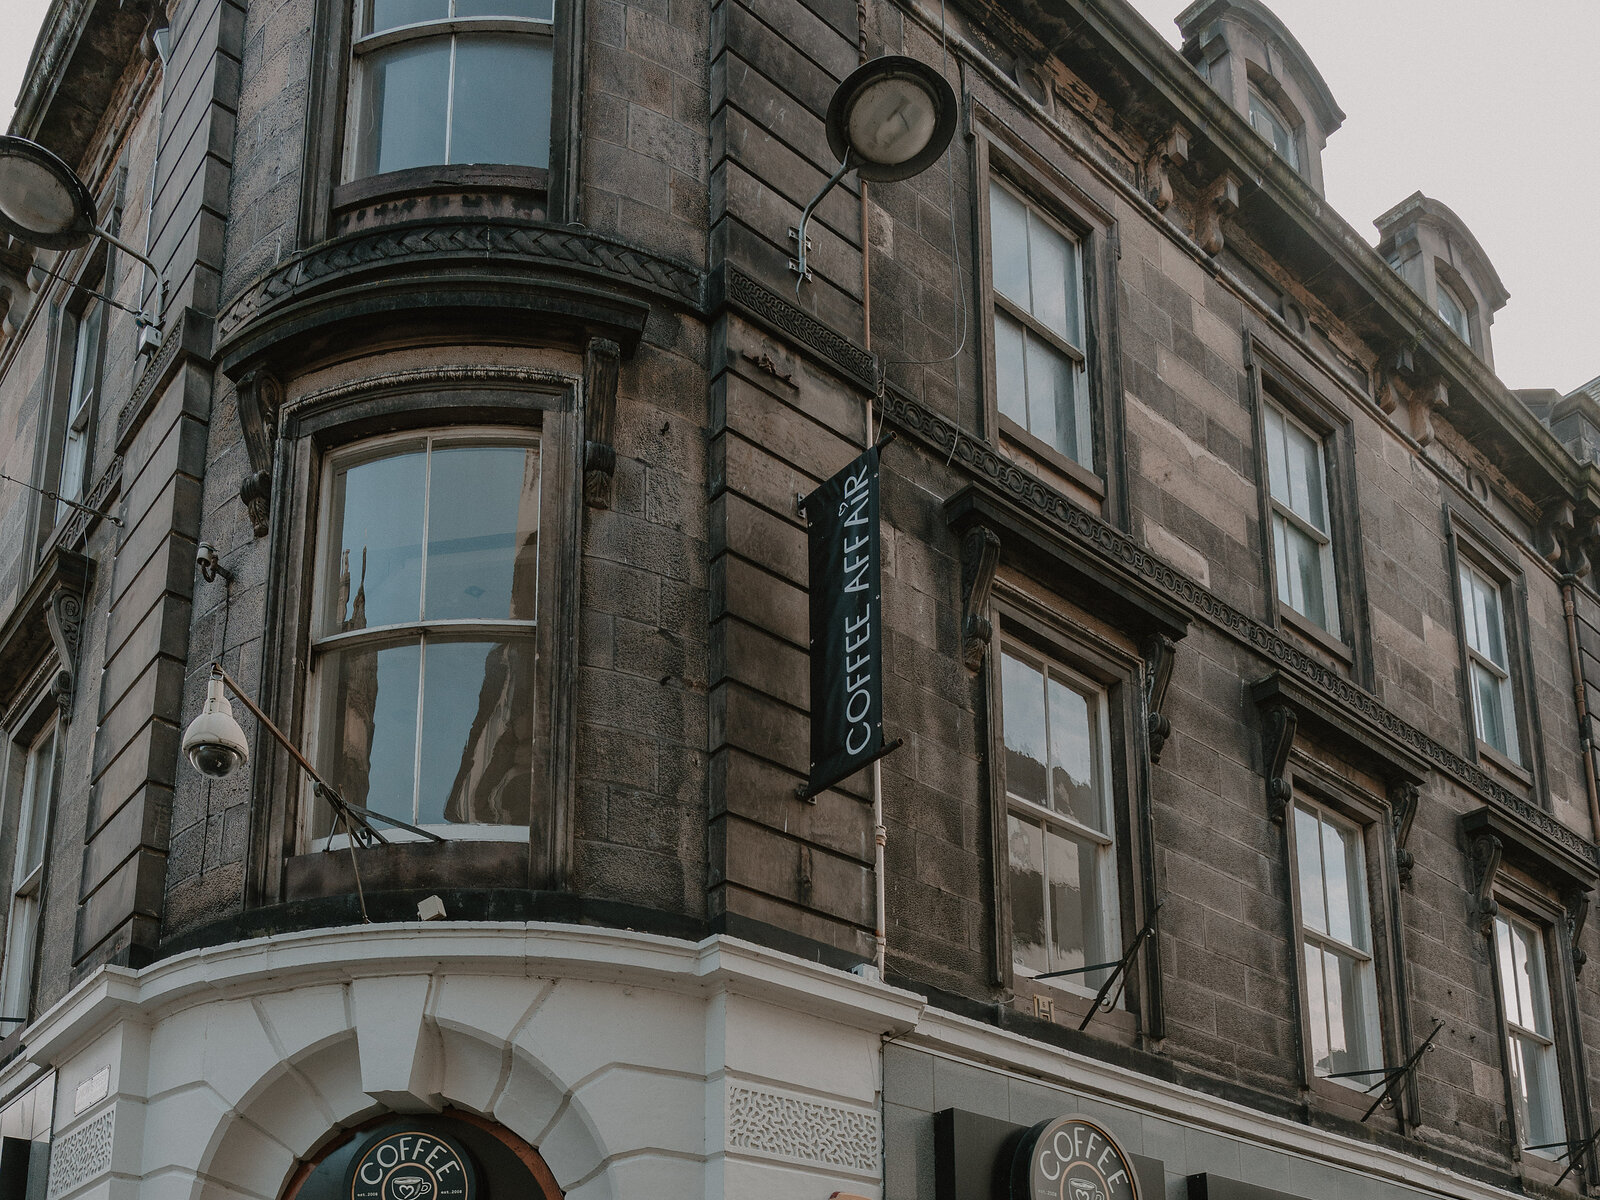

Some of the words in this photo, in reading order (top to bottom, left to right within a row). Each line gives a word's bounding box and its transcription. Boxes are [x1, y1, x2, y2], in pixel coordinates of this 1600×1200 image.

[846, 603, 871, 755] COFFEE
[360, 1136, 460, 1182] COFFEE
[1039, 1127, 1129, 1193] COFFEE
